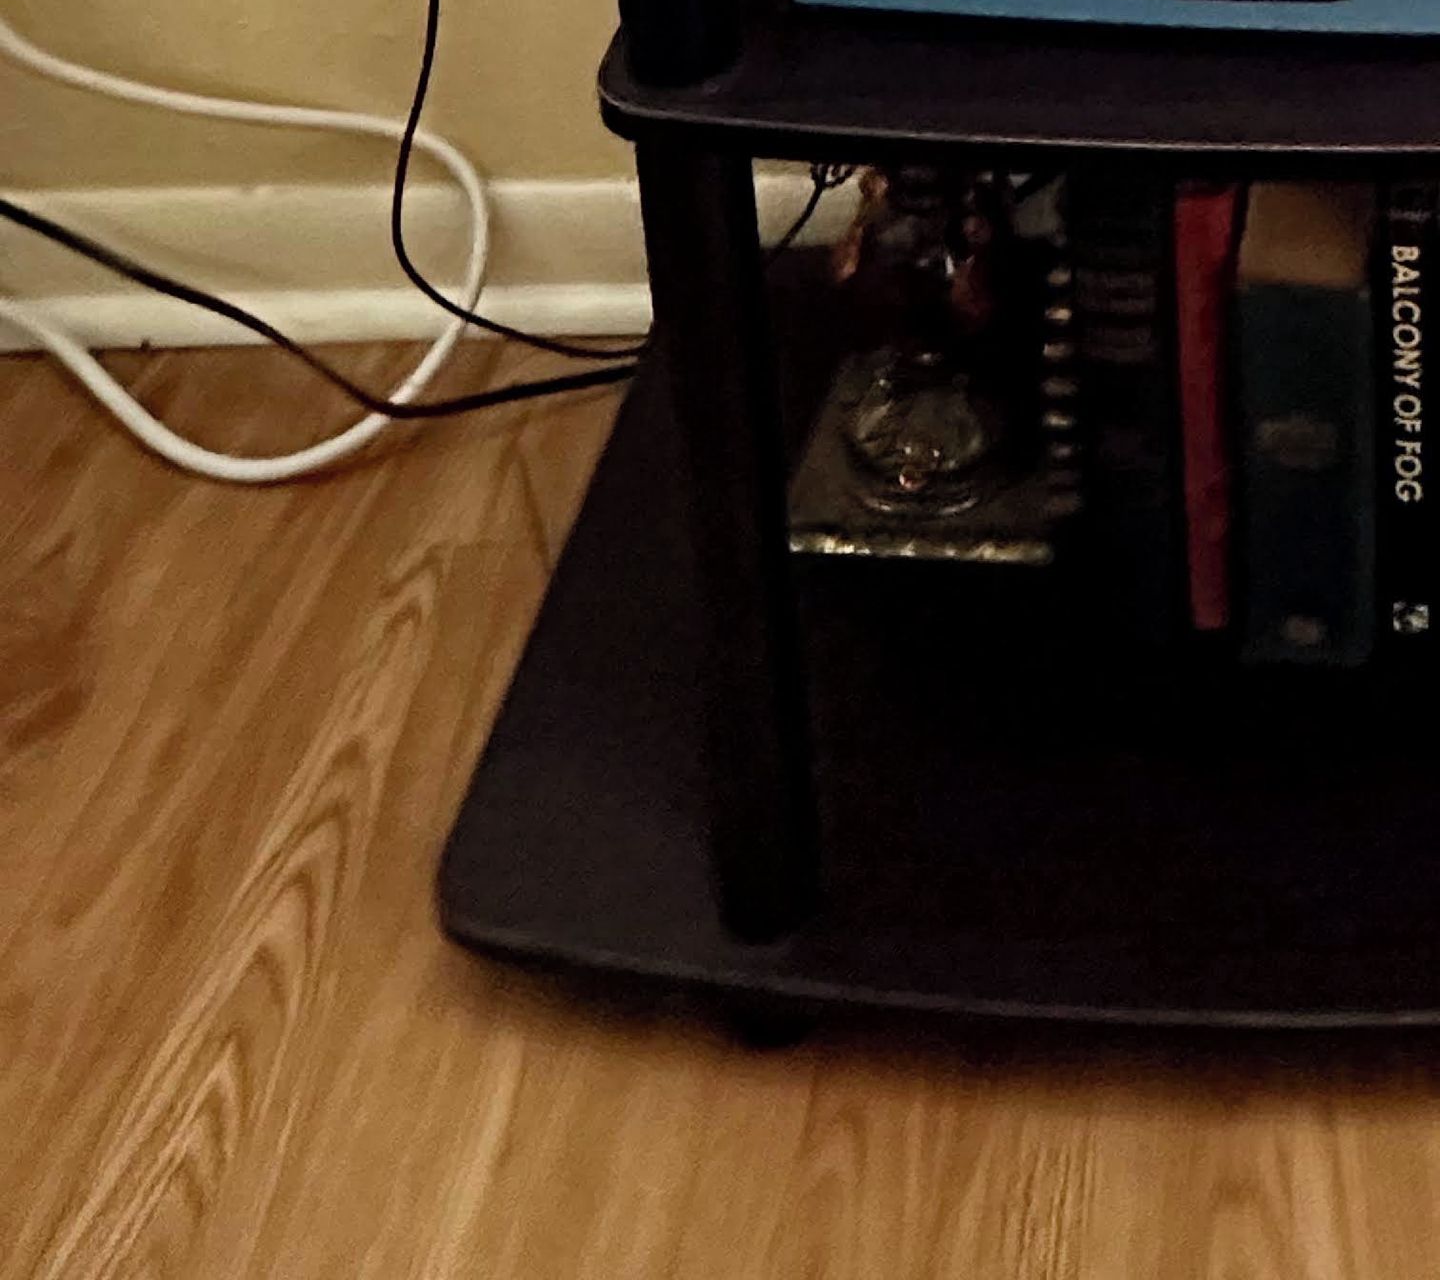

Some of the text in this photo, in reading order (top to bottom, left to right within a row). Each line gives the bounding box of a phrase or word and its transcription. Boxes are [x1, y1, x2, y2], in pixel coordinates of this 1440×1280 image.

[1391, 244, 1423, 503] BALCONY OF FOG
